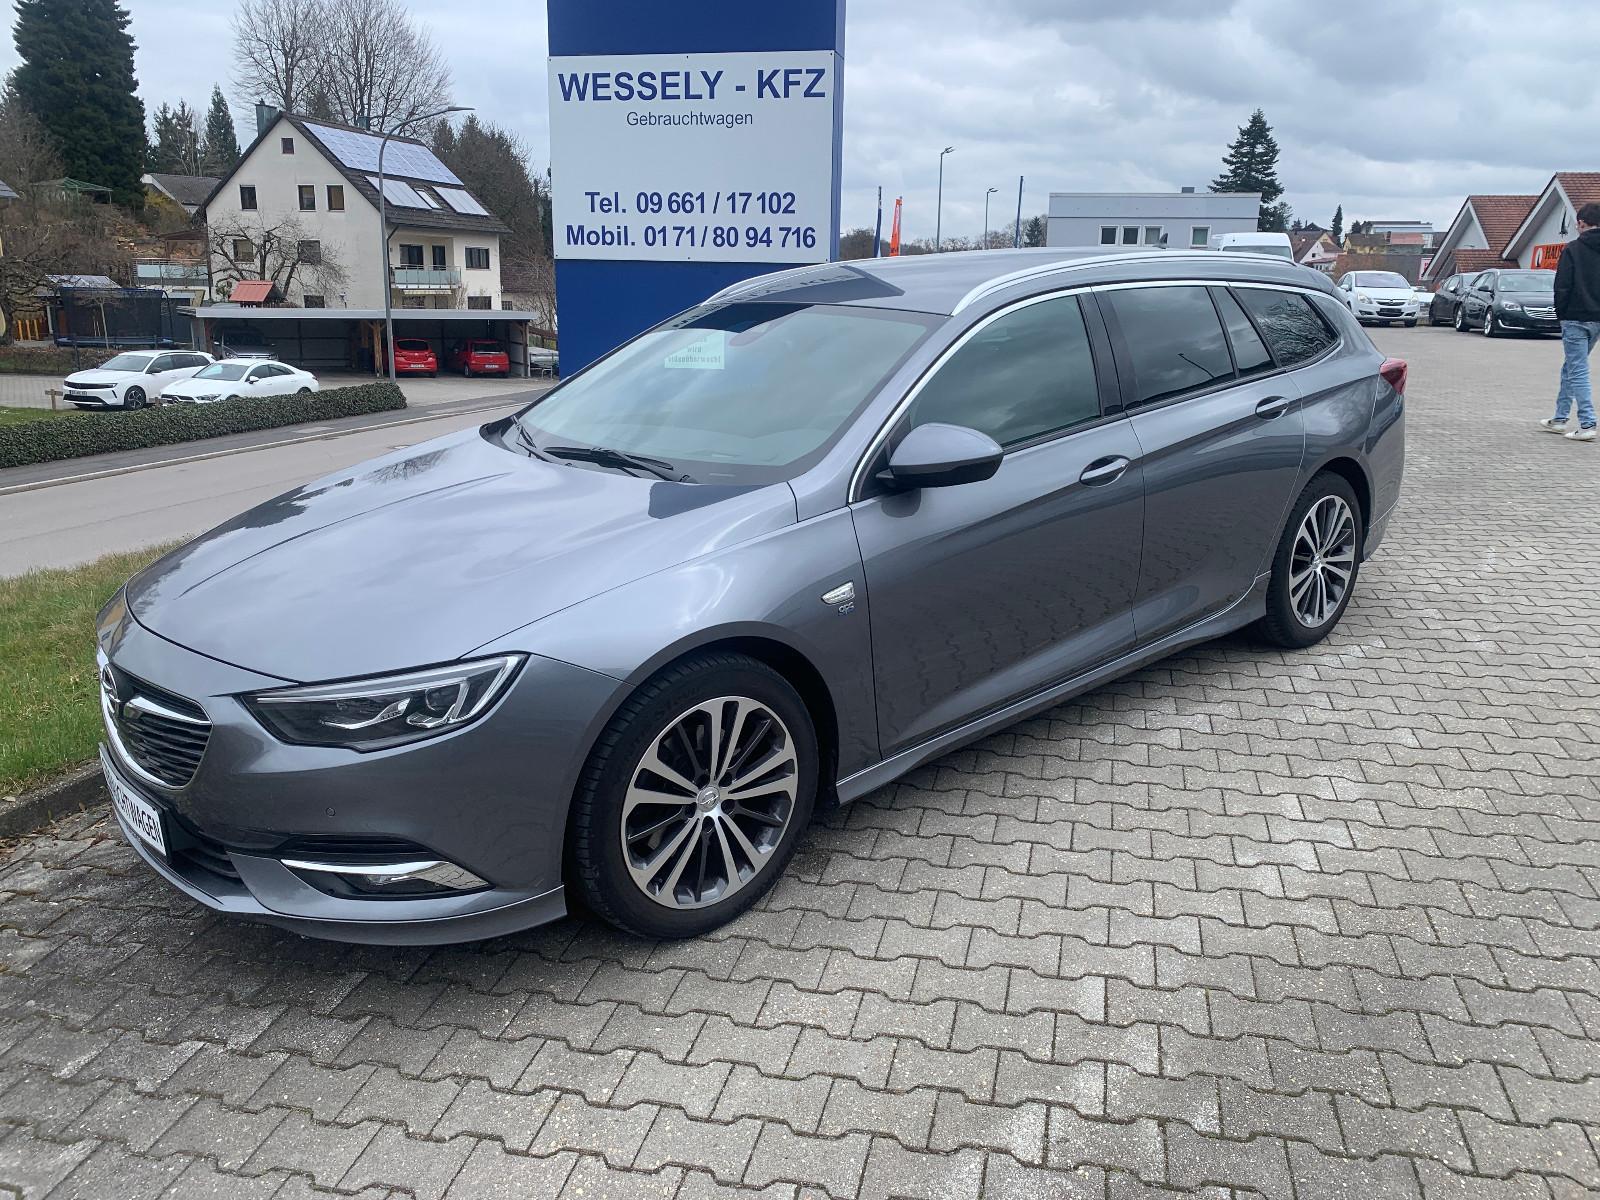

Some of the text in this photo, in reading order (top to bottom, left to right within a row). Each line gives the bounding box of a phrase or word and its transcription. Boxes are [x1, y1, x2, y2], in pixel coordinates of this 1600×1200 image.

[558, 70, 724, 102] WESSELY
[757, 68, 826, 99] KFZ
[626, 110, 754, 129] Gebrauchtwagen
[585, 191, 627, 214] Tel.
[566, 224, 636, 247] Mobil.
